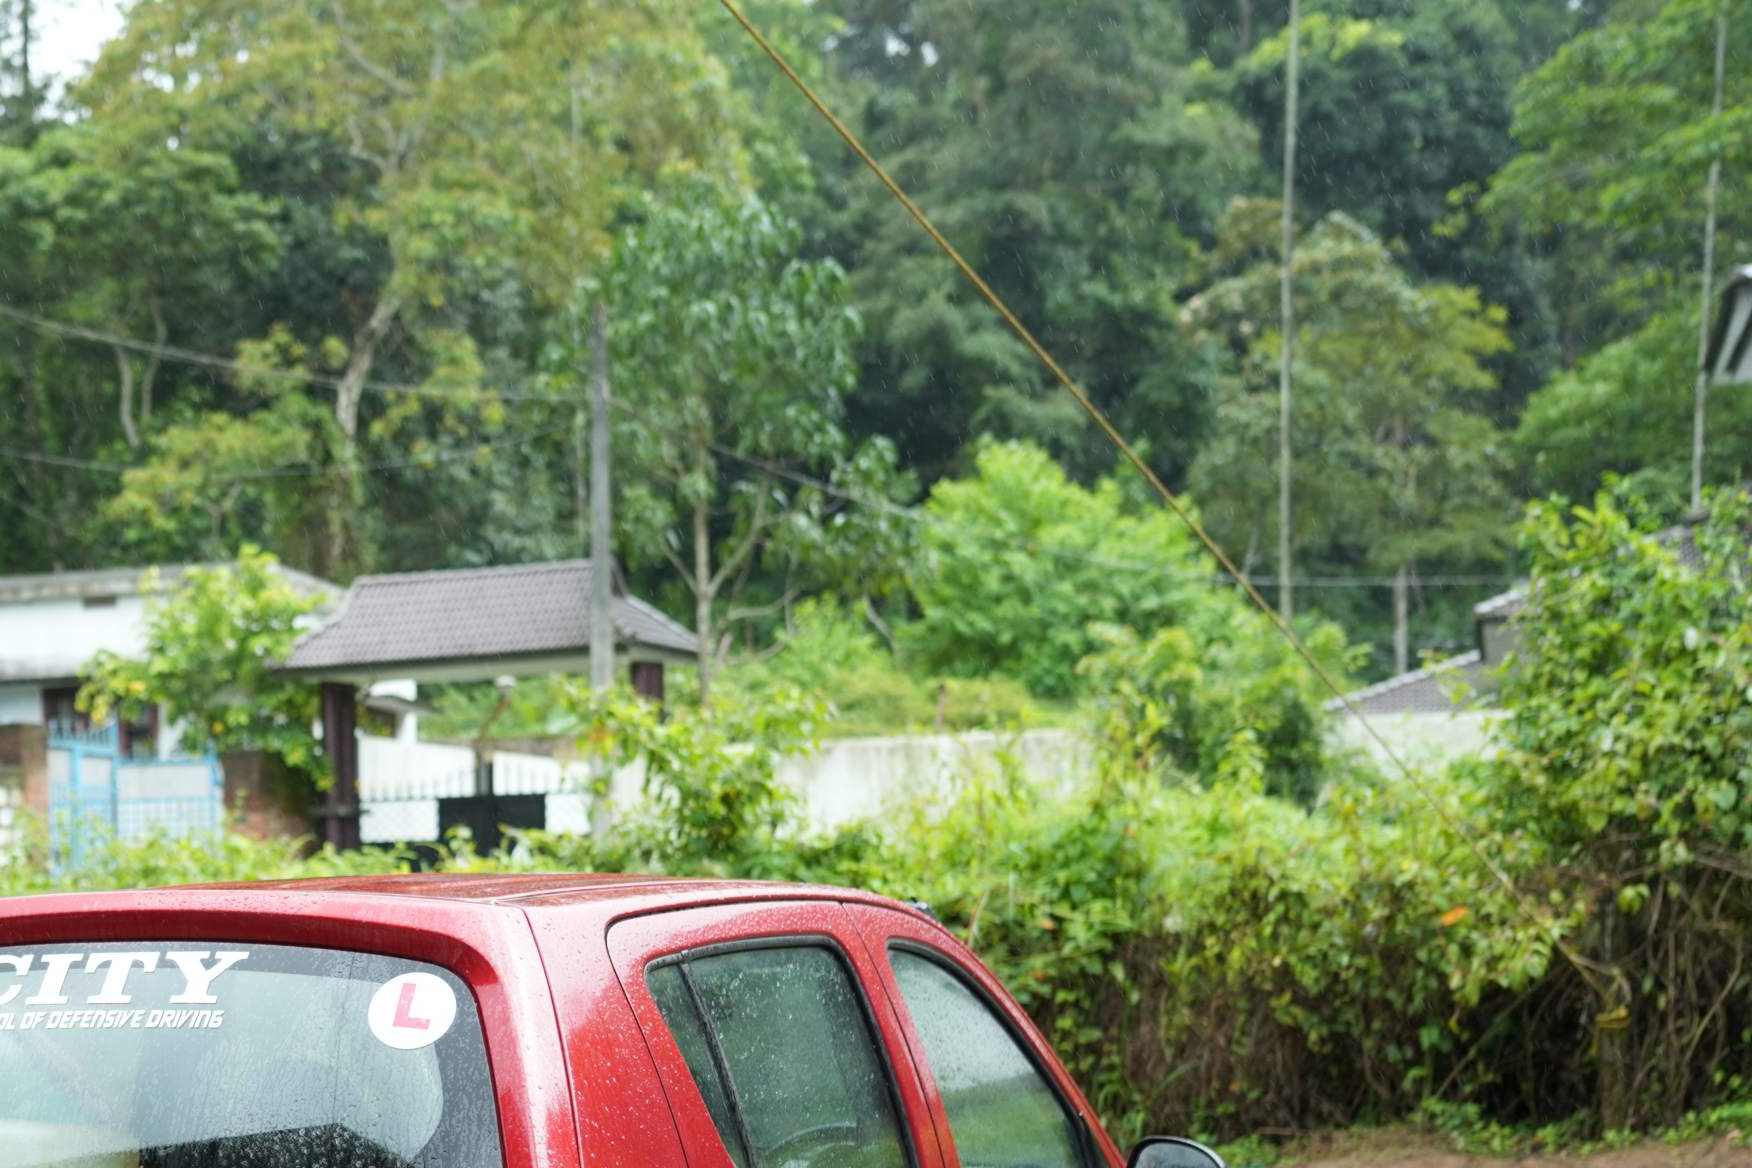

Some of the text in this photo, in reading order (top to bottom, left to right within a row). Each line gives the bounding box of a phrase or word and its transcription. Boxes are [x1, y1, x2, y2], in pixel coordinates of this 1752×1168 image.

[19, 1011, 47, 1030] OF
[48, 1009, 147, 1029] DEFENSIVE
[145, 1009, 225, 1030] DRIVING
[391, 982, 431, 1030] L
